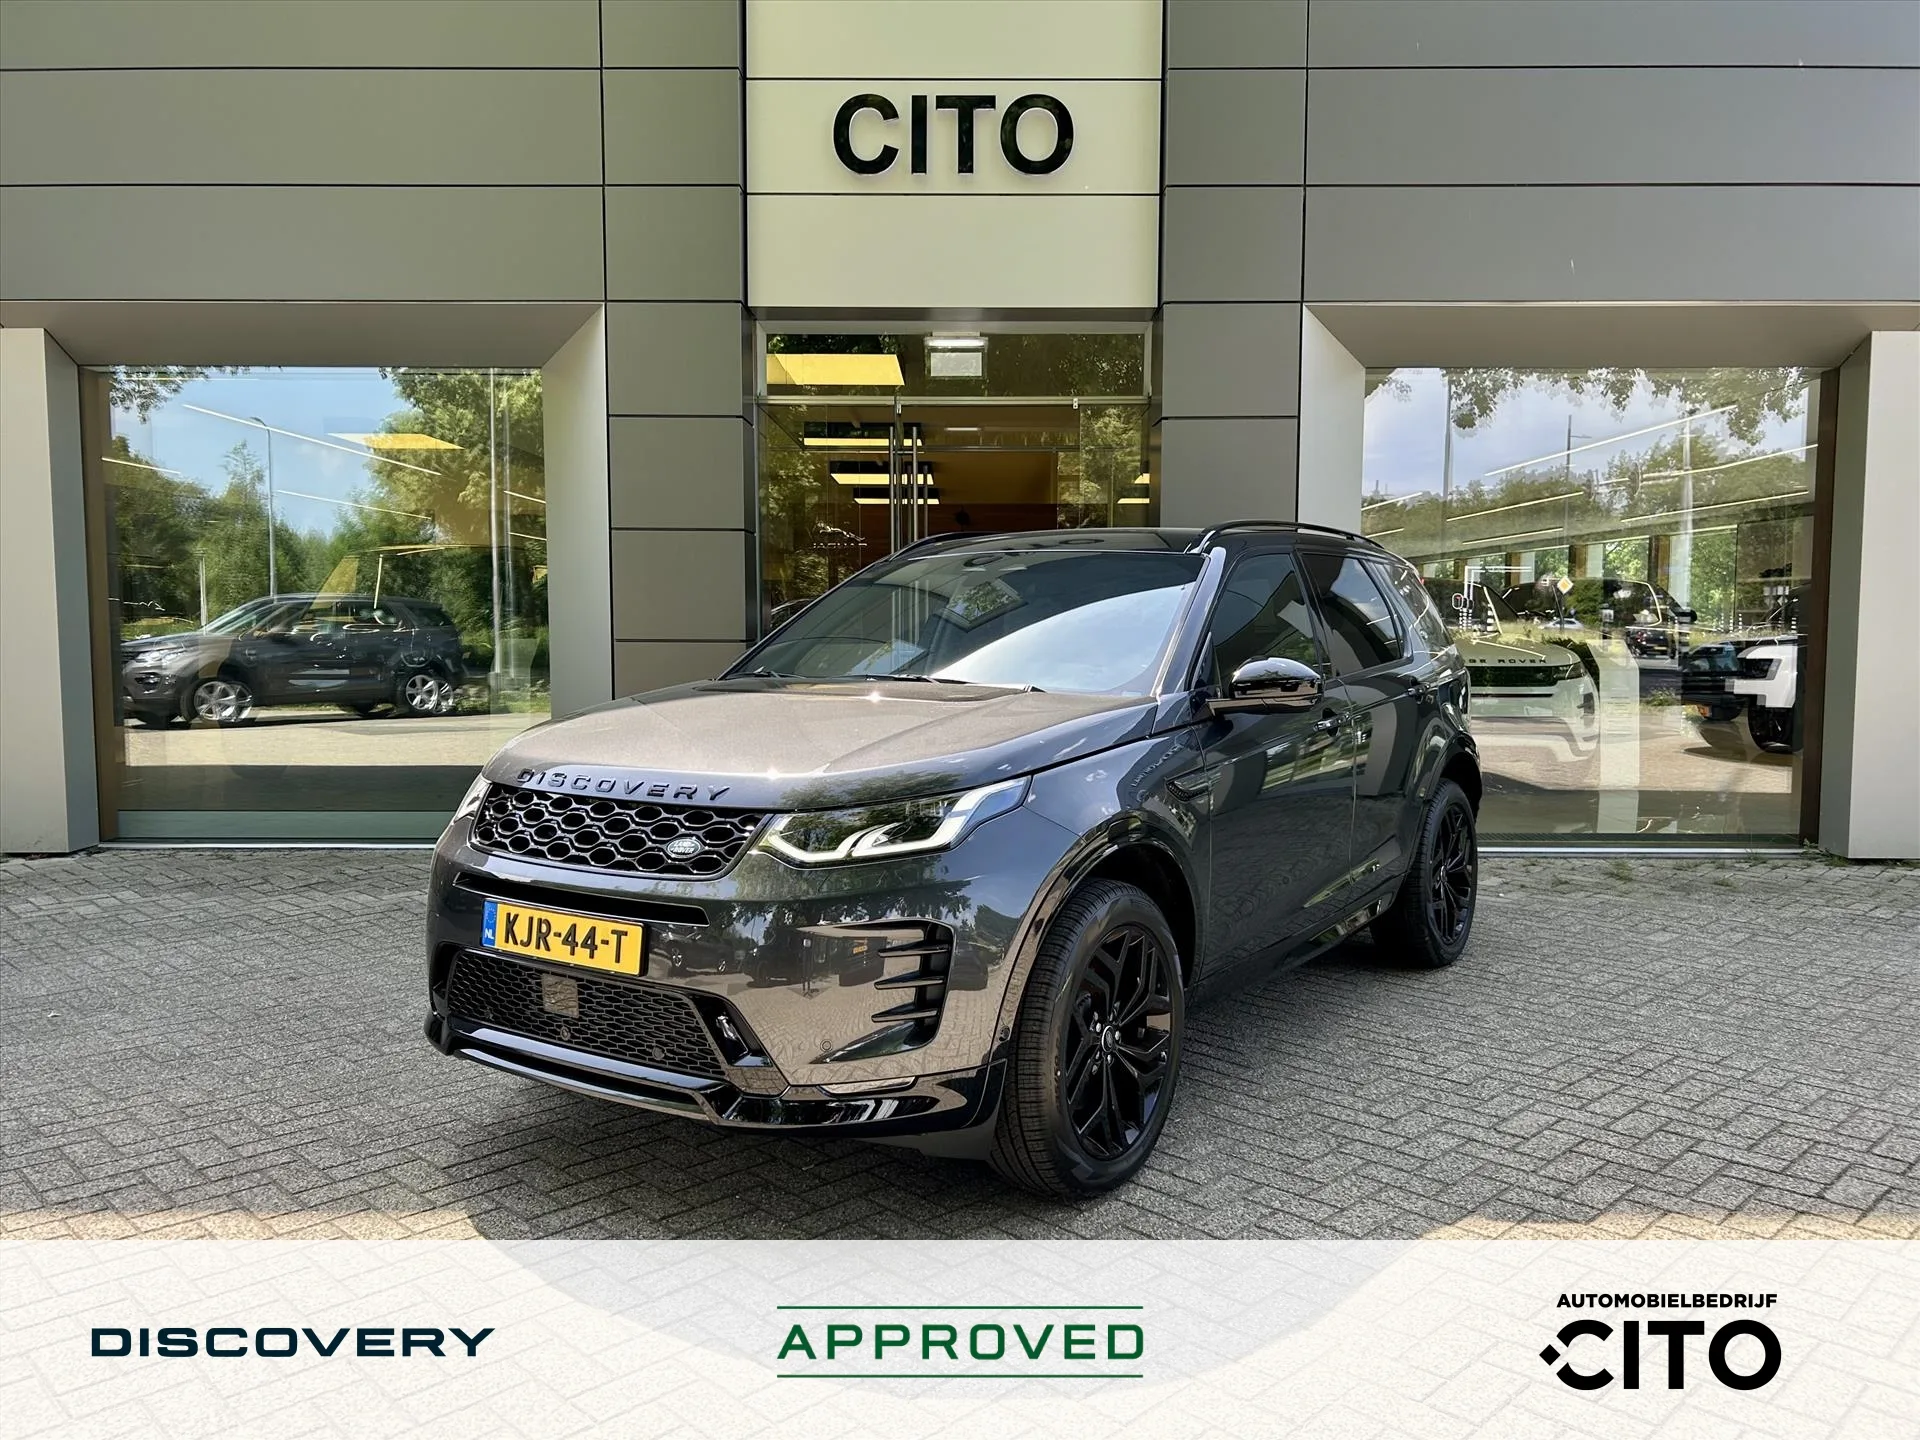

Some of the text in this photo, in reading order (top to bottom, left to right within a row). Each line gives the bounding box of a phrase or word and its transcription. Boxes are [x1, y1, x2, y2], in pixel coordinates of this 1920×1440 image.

[833, 93, 1074, 175] CITO
[516, 768, 731, 801] DISCOVERY
[484, 928, 494, 940] NL
[504, 912, 628, 964] KJR-44-T
